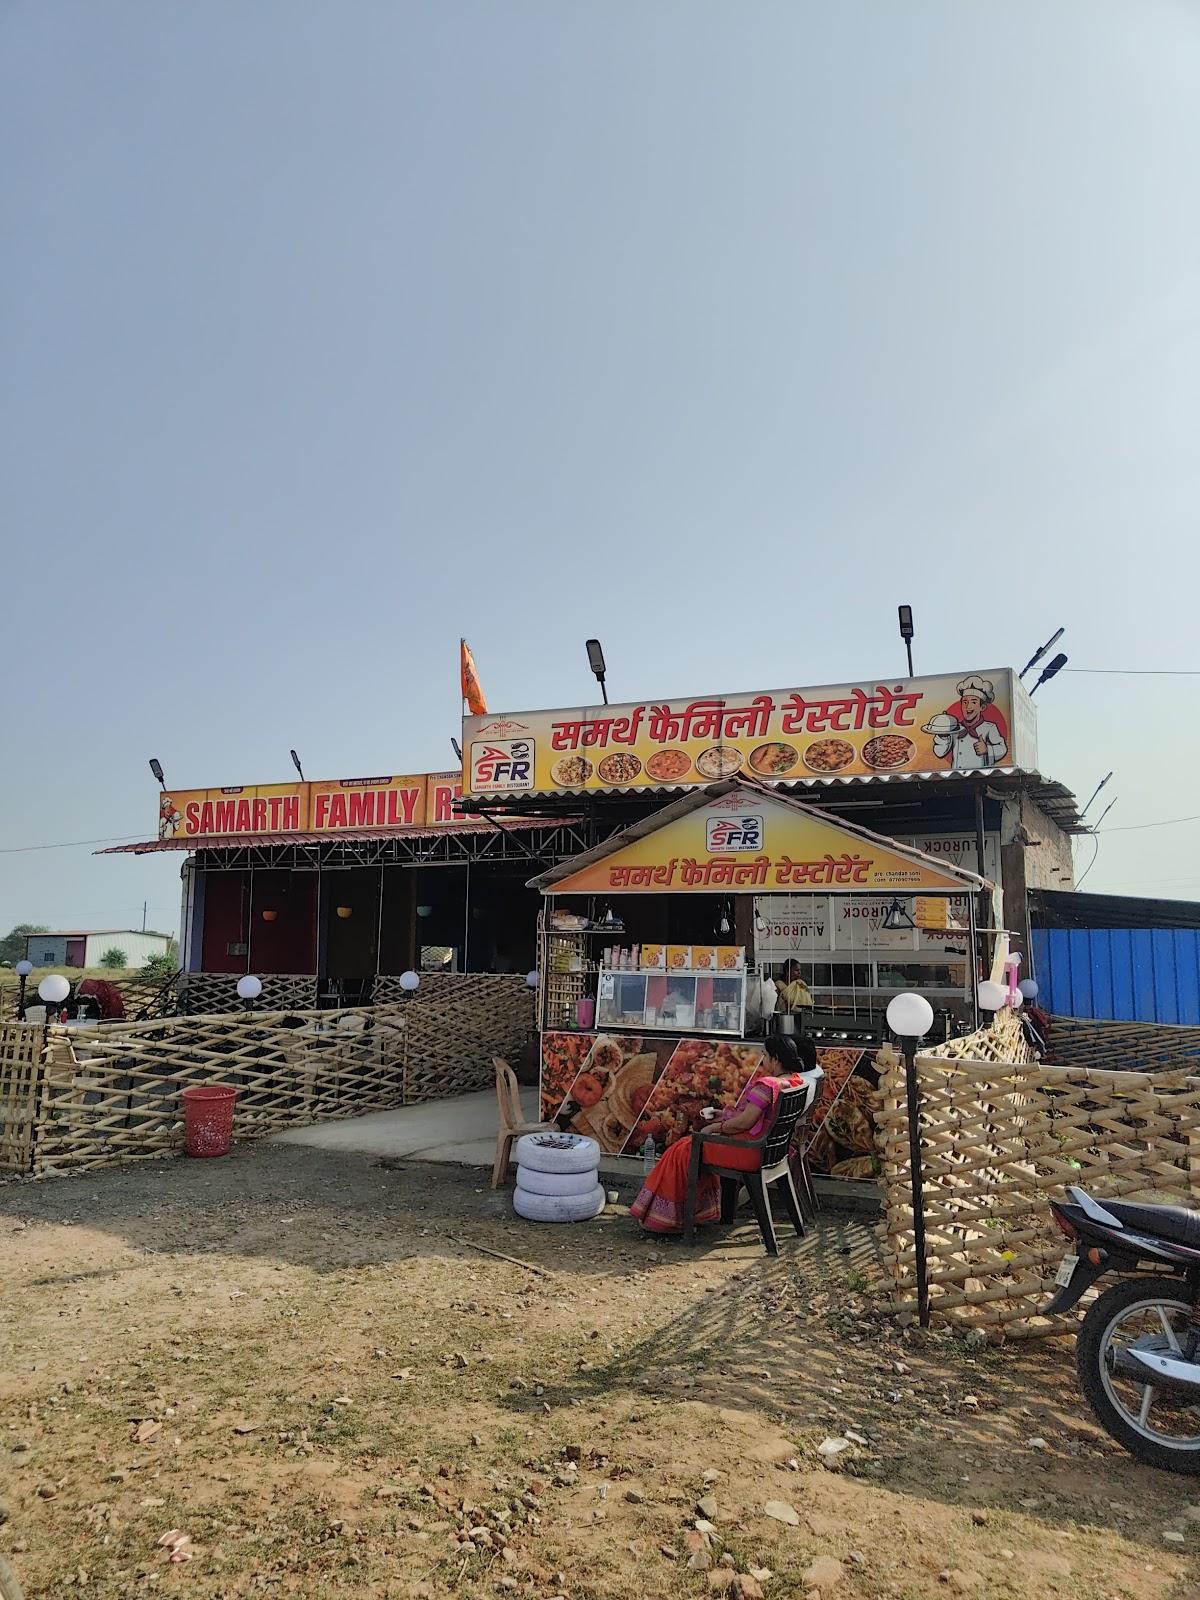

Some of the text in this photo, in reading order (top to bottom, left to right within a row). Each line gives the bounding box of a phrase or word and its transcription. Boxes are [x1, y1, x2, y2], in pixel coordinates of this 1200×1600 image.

[551, 685, 923, 750] समर्थ फैमिली रेस्टोरेंट
[475, 762, 530, 782] SFR
[186, 797, 299, 835] SAMARTH
[315, 788, 419, 829] FAMILY
[711, 831, 759, 845] SFR
[609, 853, 873, 886] समर्थ फैमिली रेस्टोरेंट
